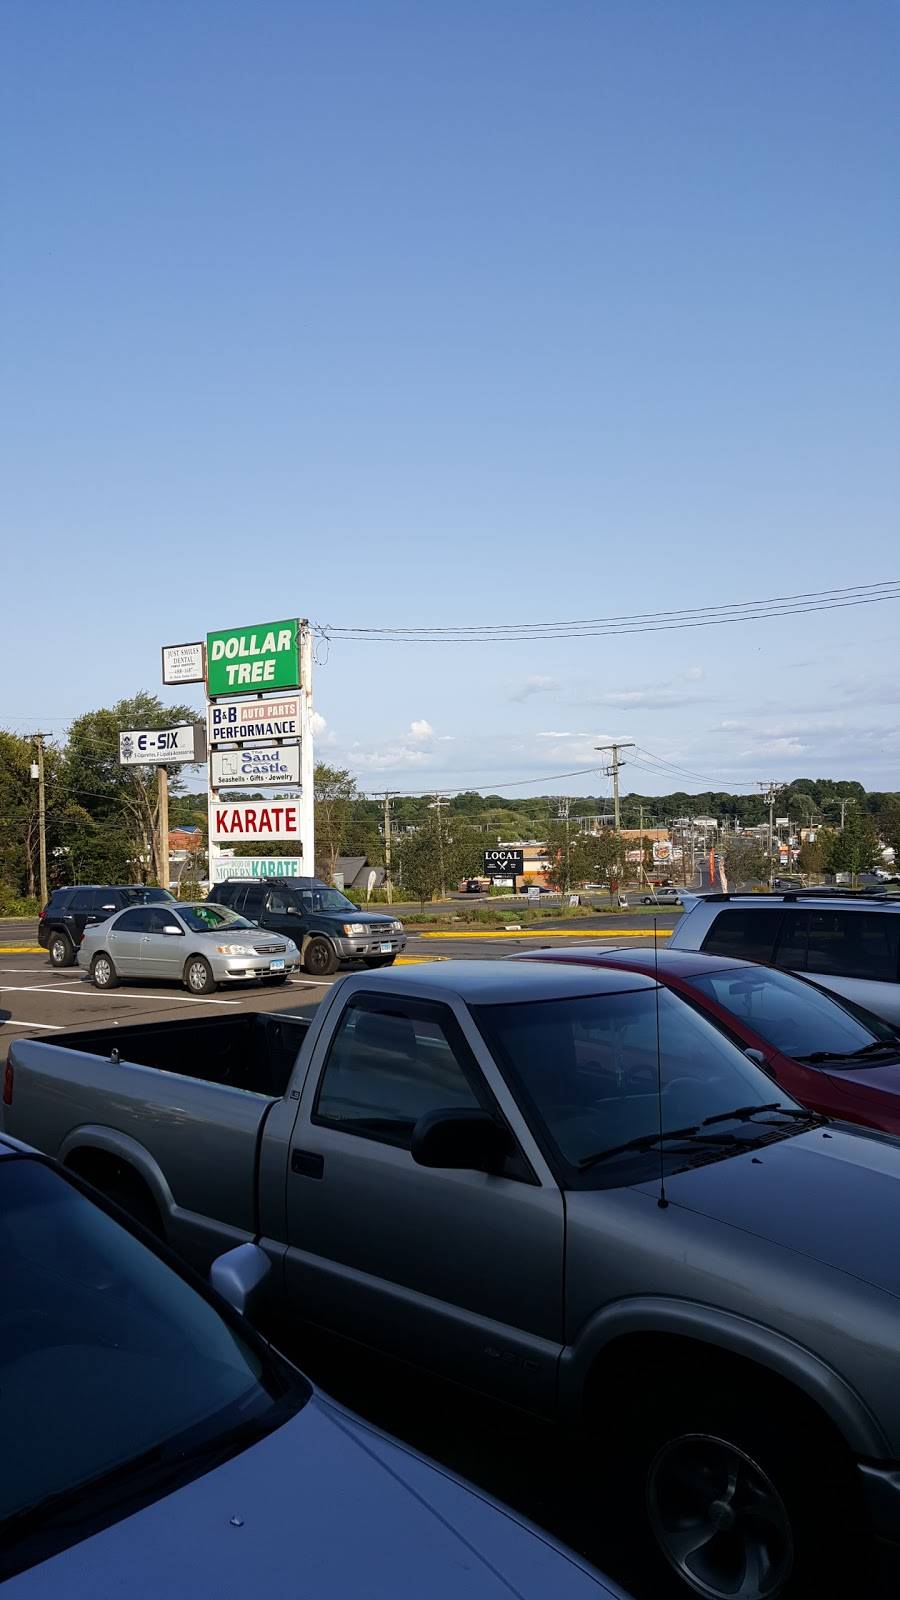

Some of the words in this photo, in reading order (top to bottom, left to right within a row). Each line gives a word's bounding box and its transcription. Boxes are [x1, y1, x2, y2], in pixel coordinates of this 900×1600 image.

[212, 630, 292, 660] DOLLAR
[226, 660, 276, 685] TREE
[213, 707, 237, 724] B&B
[242, 707, 264, 720] AUTO
[267, 704, 295, 716] PARTS
[213, 721, 296, 740] PERFORMANCE
[242, 750, 280, 762] Sand
[241, 762, 288, 774] Castle
[218, 775, 244, 783] Seashells
[216, 808, 297, 833] KARATE
[485, 852, 520, 860] LOCAL
[252, 861, 298, 878] KARATE
